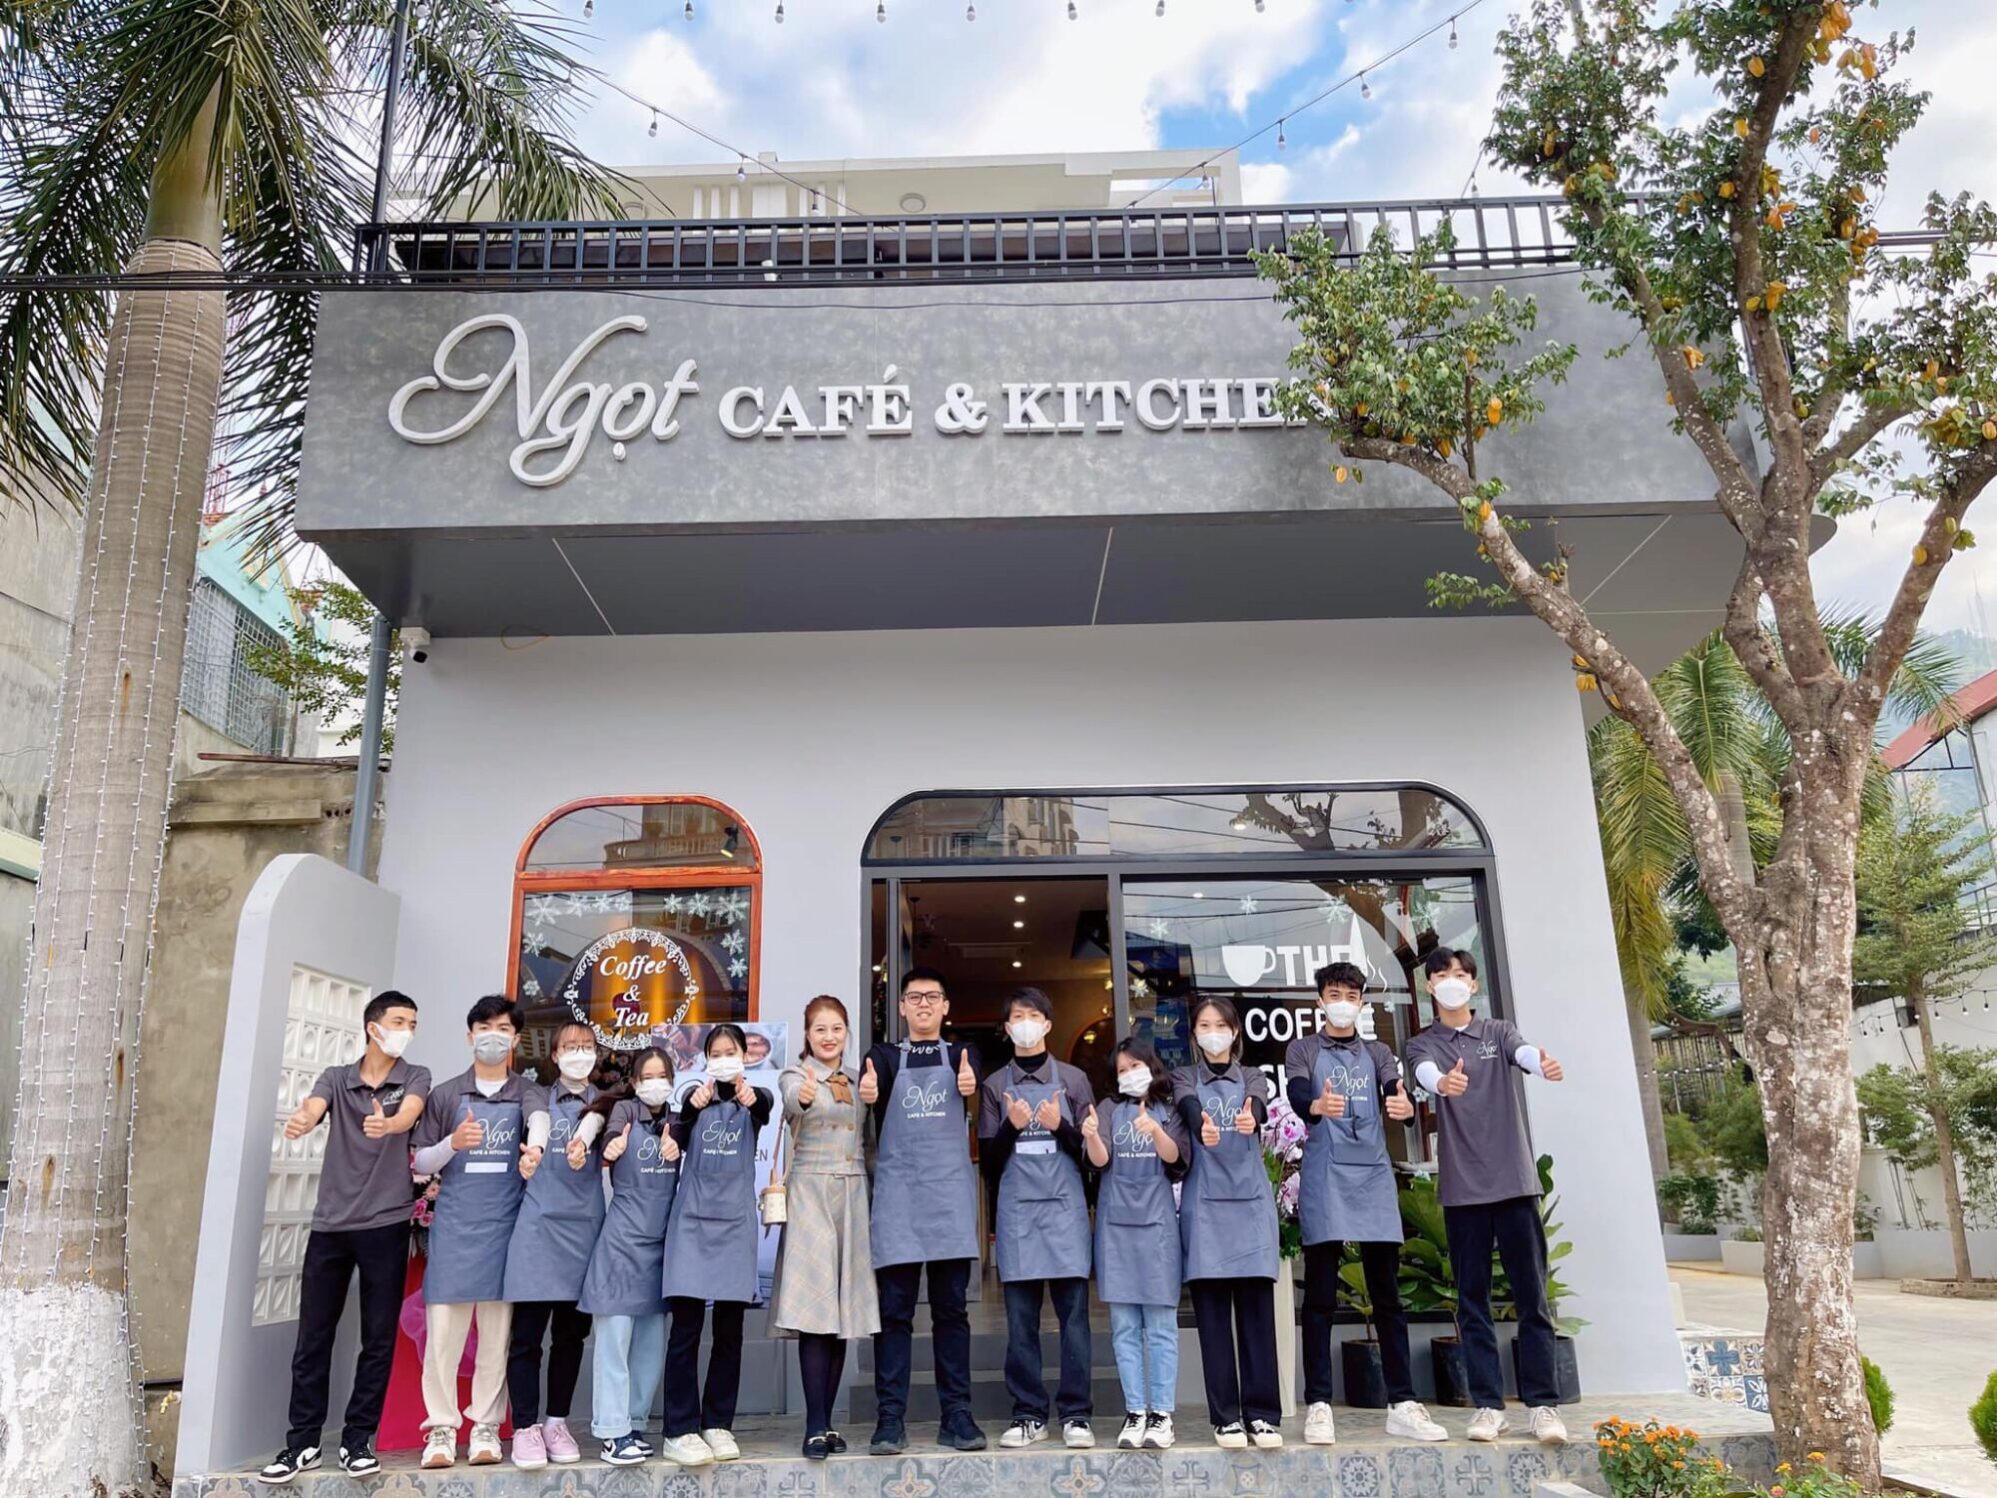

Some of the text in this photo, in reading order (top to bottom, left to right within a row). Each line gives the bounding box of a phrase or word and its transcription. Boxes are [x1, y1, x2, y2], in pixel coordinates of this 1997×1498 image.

[388, 313, 1336, 487] Ngọt CAFÉ & KITCHE
[600, 955, 667, 980] Coffee
[623, 984, 641, 1002] &
[614, 1006, 649, 1028] Tea
[902, 1081, 947, 1112] Ngọt
